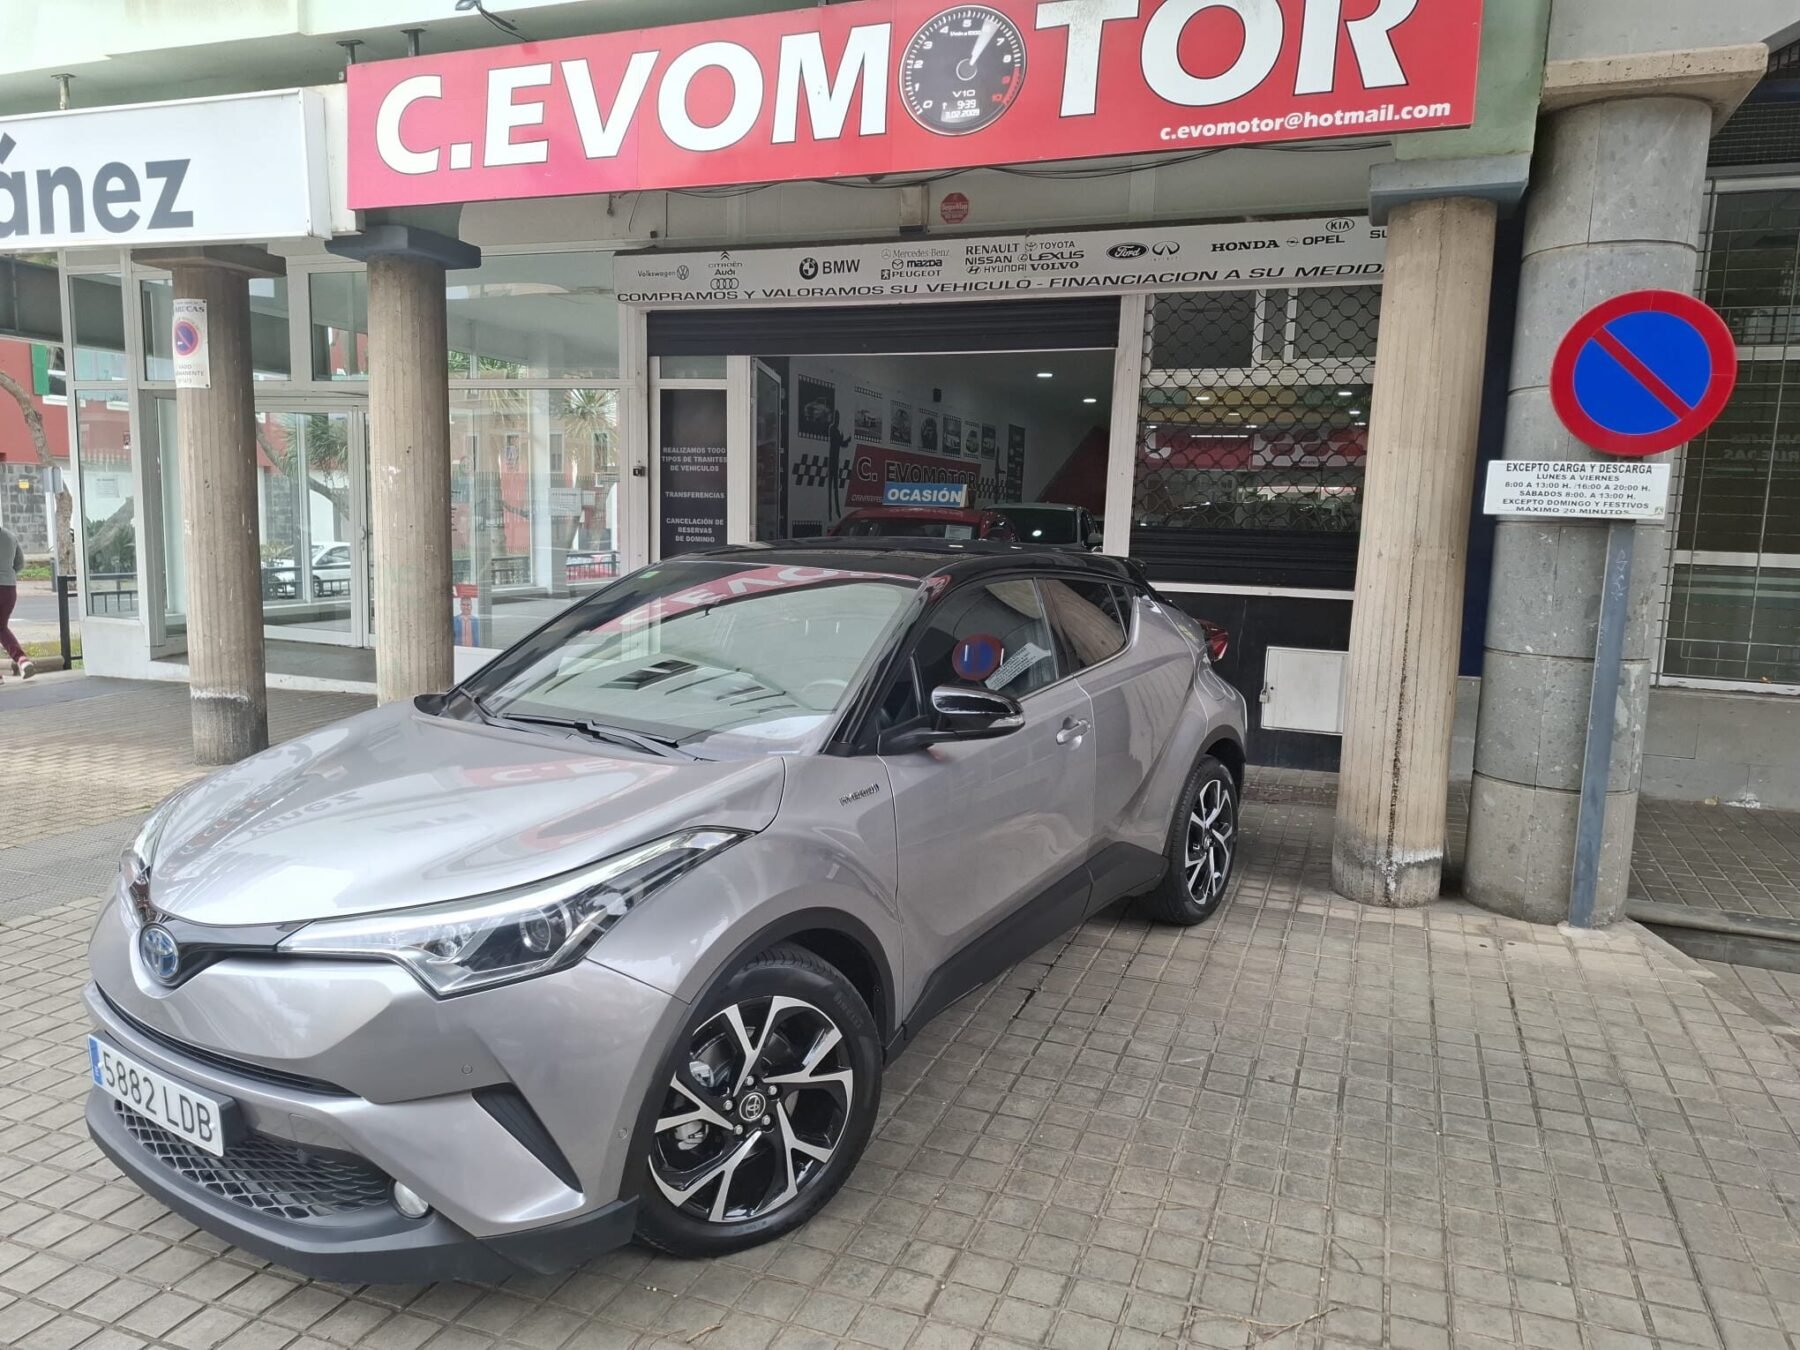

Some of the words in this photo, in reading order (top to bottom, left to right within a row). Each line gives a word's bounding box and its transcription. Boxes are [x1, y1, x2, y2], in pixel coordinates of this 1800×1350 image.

[952, 89, 976, 98] V10
[1160, 101, 1450, 141] c.evomotor@hotmail.com
[1330, 221, 1350, 230] KIA
[1302, 234, 1345, 246] OPEL
[966, 243, 1020, 255] RENAULT
[1039, 241, 1075, 250] TOYOTA
[1211, 239, 1281, 253] HONDA
[1029, 251, 1084, 261] LEXUS
[1114, 246, 1141, 257] Ford
[965, 255, 1012, 266] NISSAN
[822, 259, 860, 274] BMW
[984, 263, 1027, 273] HYUNDAI
[1030, 261, 1079, 271] VOLVO
[637, 269, 676, 278] Volkswagen
[714, 268, 736, 276] Audi
[892, 269, 941, 278] PEUGEOT
[617, 290, 738, 302] COMPRAMOS
[744, 290, 755, 299] Y
[762, 286, 884, 298] VALORAMOS
[890, 284, 918, 294] SU
[927, 279, 1031, 293] VEHICULO
[1049, 270, 1218, 288] FINANCIACION
[1224, 270, 1241, 280] A
[1248, 267, 1285, 278] SU
[1295, 263, 1385, 277] MEDID
[1506, 463, 1550, 472] EXCEPTO
[1552, 463, 1586, 473] CARGA
[1590, 464, 1596, 473] Y
[1599, 464, 1652, 474] DESCARGA
[1579, 474, 1620, 482] VIERNES
[665, 491, 725, 499] TRANSFERENCIAS
[887, 487, 961, 502] OCASIÓN
[1547, 499, 1591, 507] DOMINGO
[1603, 501, 1649, 509] FESTIVOS
[686, 535, 715, 543] DOMINIO
[103, 1051, 157, 1115] 5882
[163, 1085, 213, 1143] LDB
